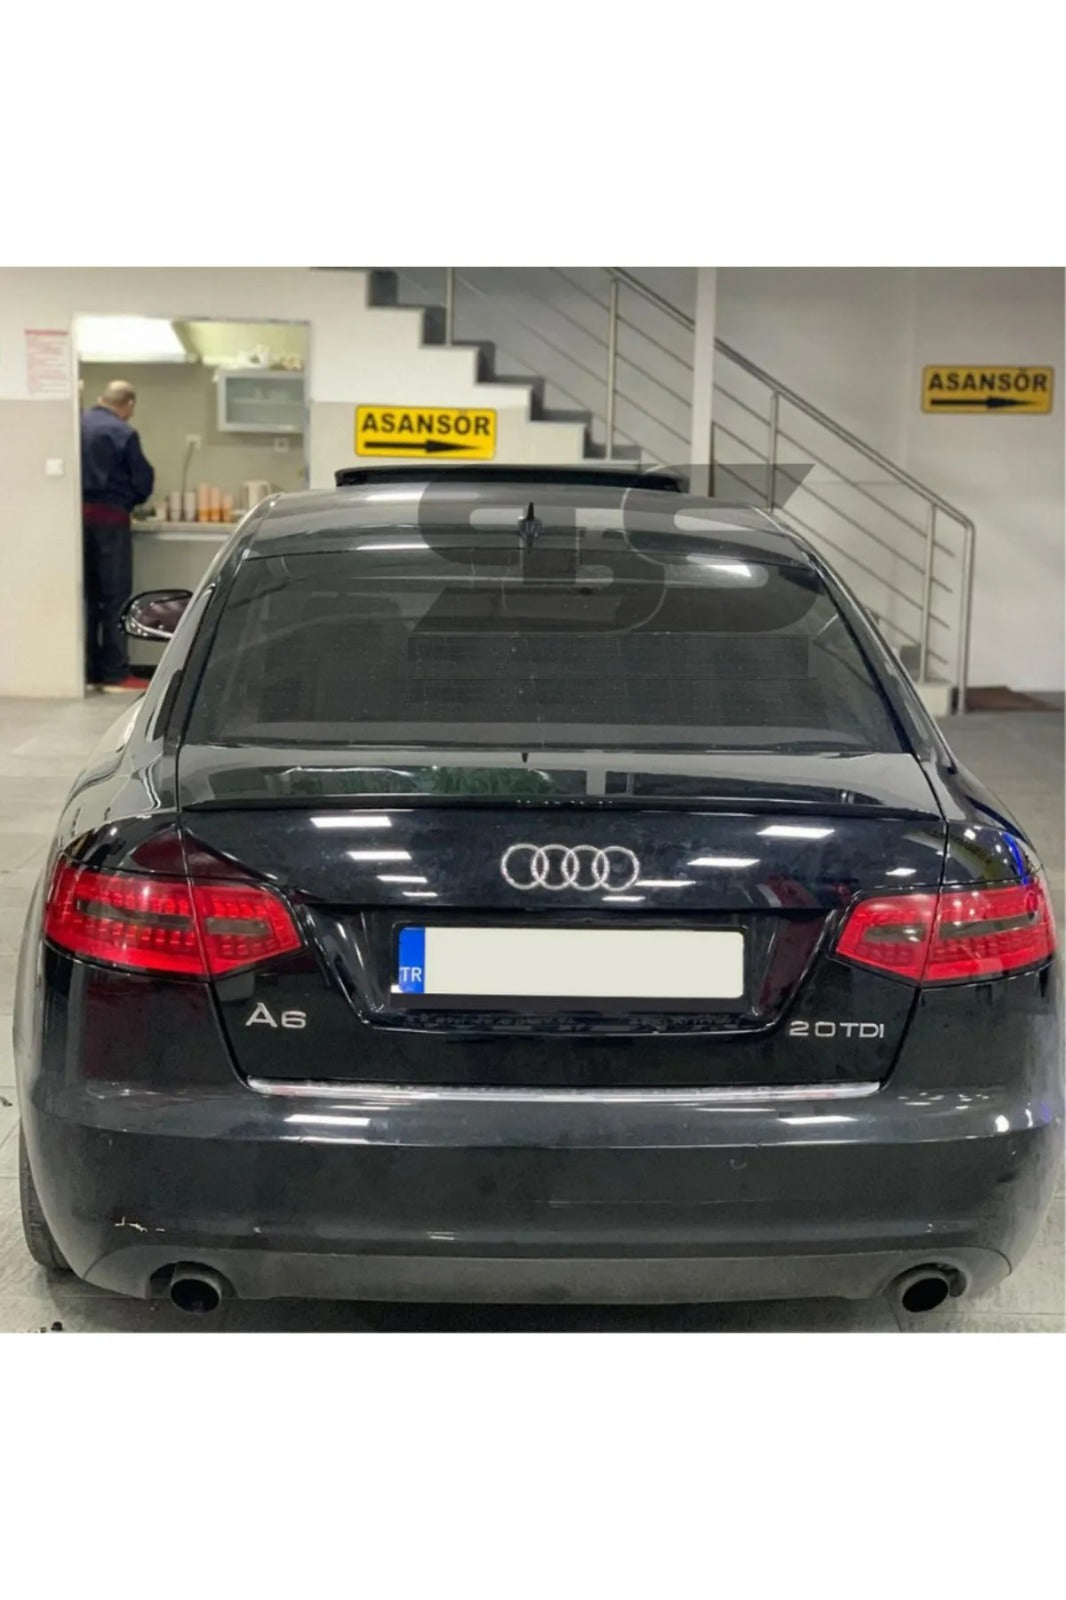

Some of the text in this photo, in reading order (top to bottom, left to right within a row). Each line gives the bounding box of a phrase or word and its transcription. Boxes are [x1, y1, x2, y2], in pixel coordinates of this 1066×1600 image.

[928, 369, 1047, 392] ASANSÖR
[362, 409, 490, 435] ASANSÖR
[400, 966, 422, 982] TR
[245, 1002, 307, 1028] A6
